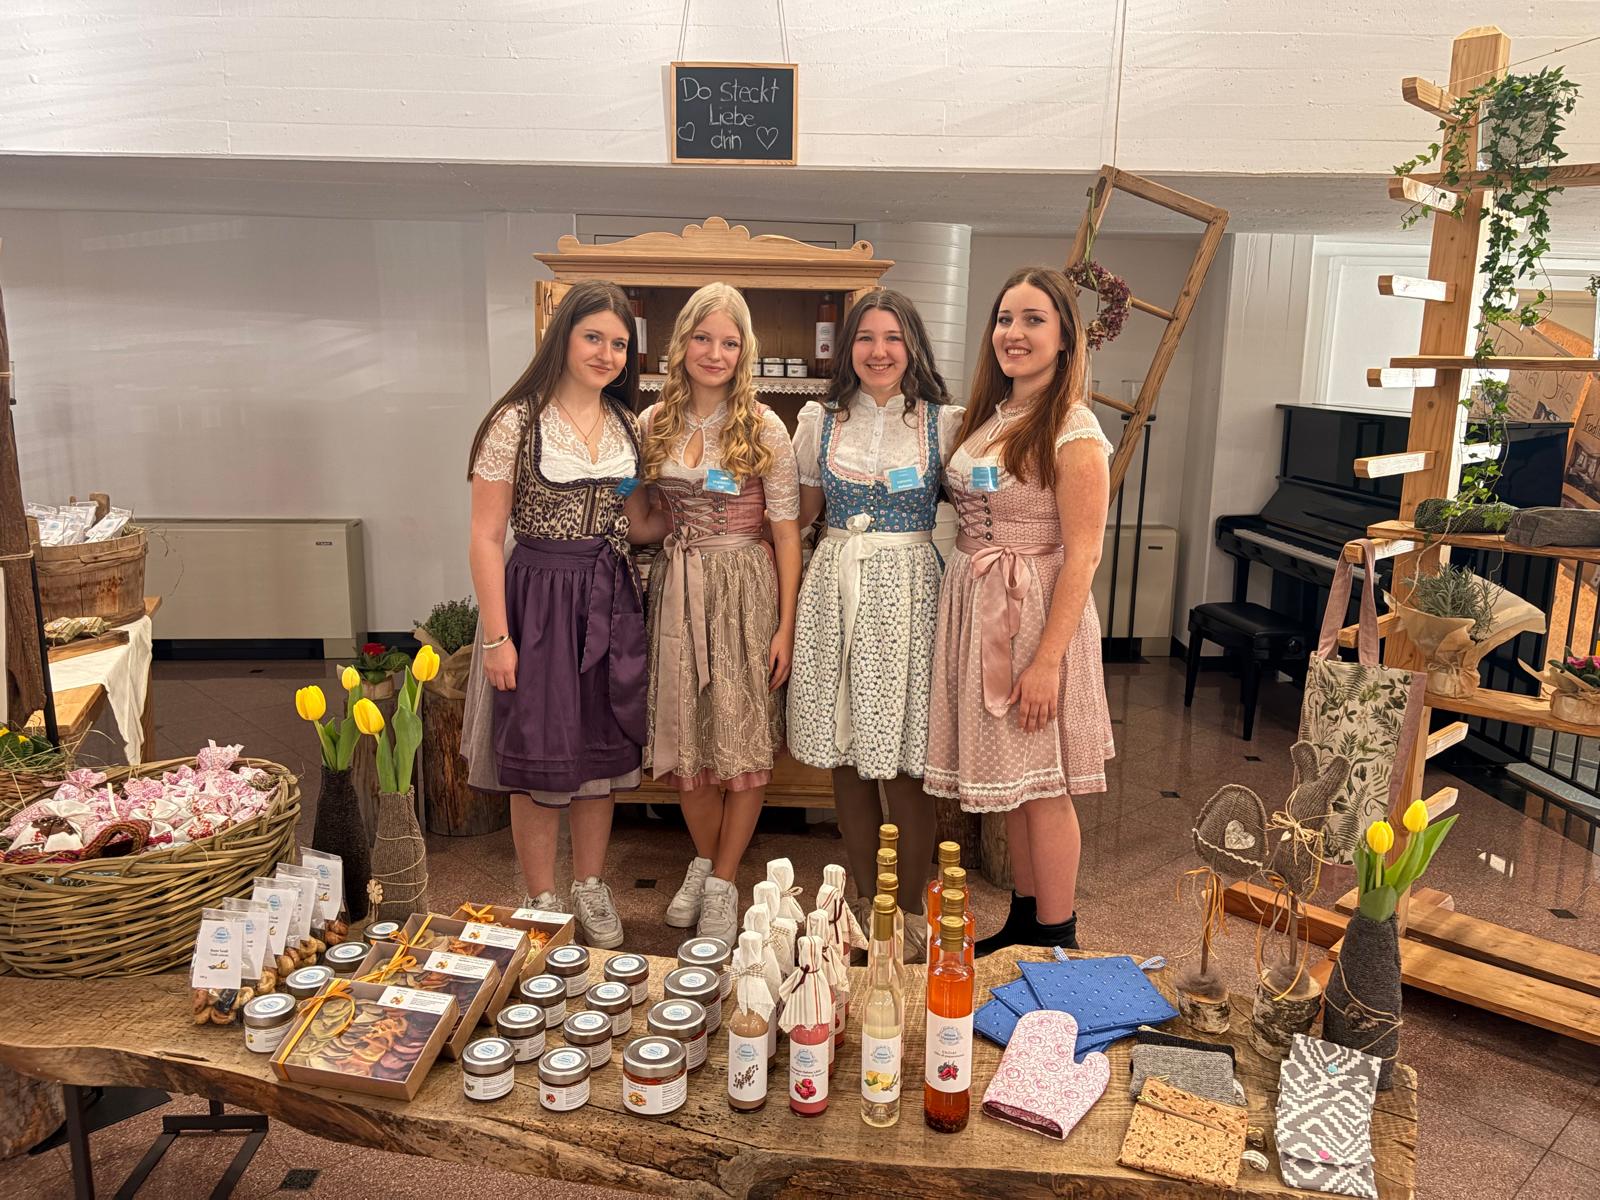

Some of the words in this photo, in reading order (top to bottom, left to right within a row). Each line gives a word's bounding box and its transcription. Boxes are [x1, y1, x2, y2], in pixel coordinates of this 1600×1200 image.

[679, 77, 712, 102] Do
[709, 103, 756, 127] Liebe
[710, 128, 742, 150] drin
